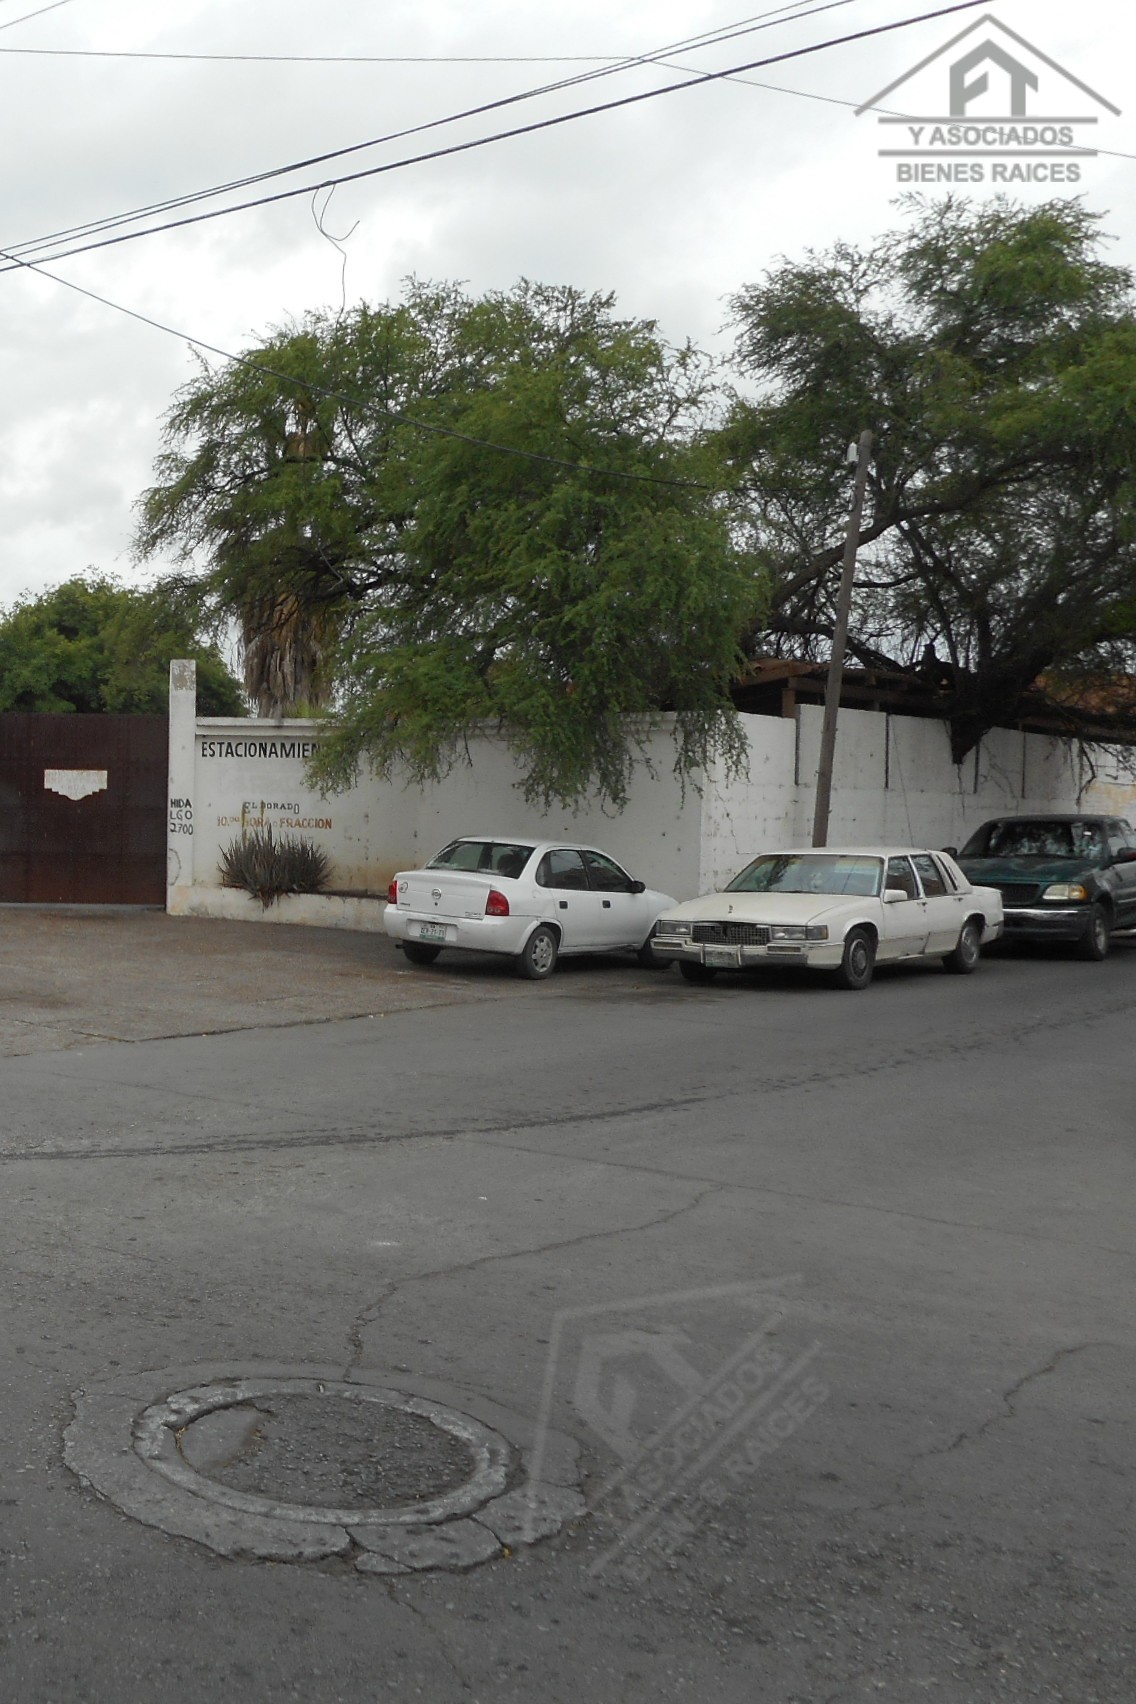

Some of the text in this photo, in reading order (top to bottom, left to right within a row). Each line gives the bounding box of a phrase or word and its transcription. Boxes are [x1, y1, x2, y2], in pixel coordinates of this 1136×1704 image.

[170, 798, 192, 809] HIDA
[169, 810, 193, 820] LGO
[280, 817, 332, 829] FRACCION
[170, 823, 194, 835] 2700
